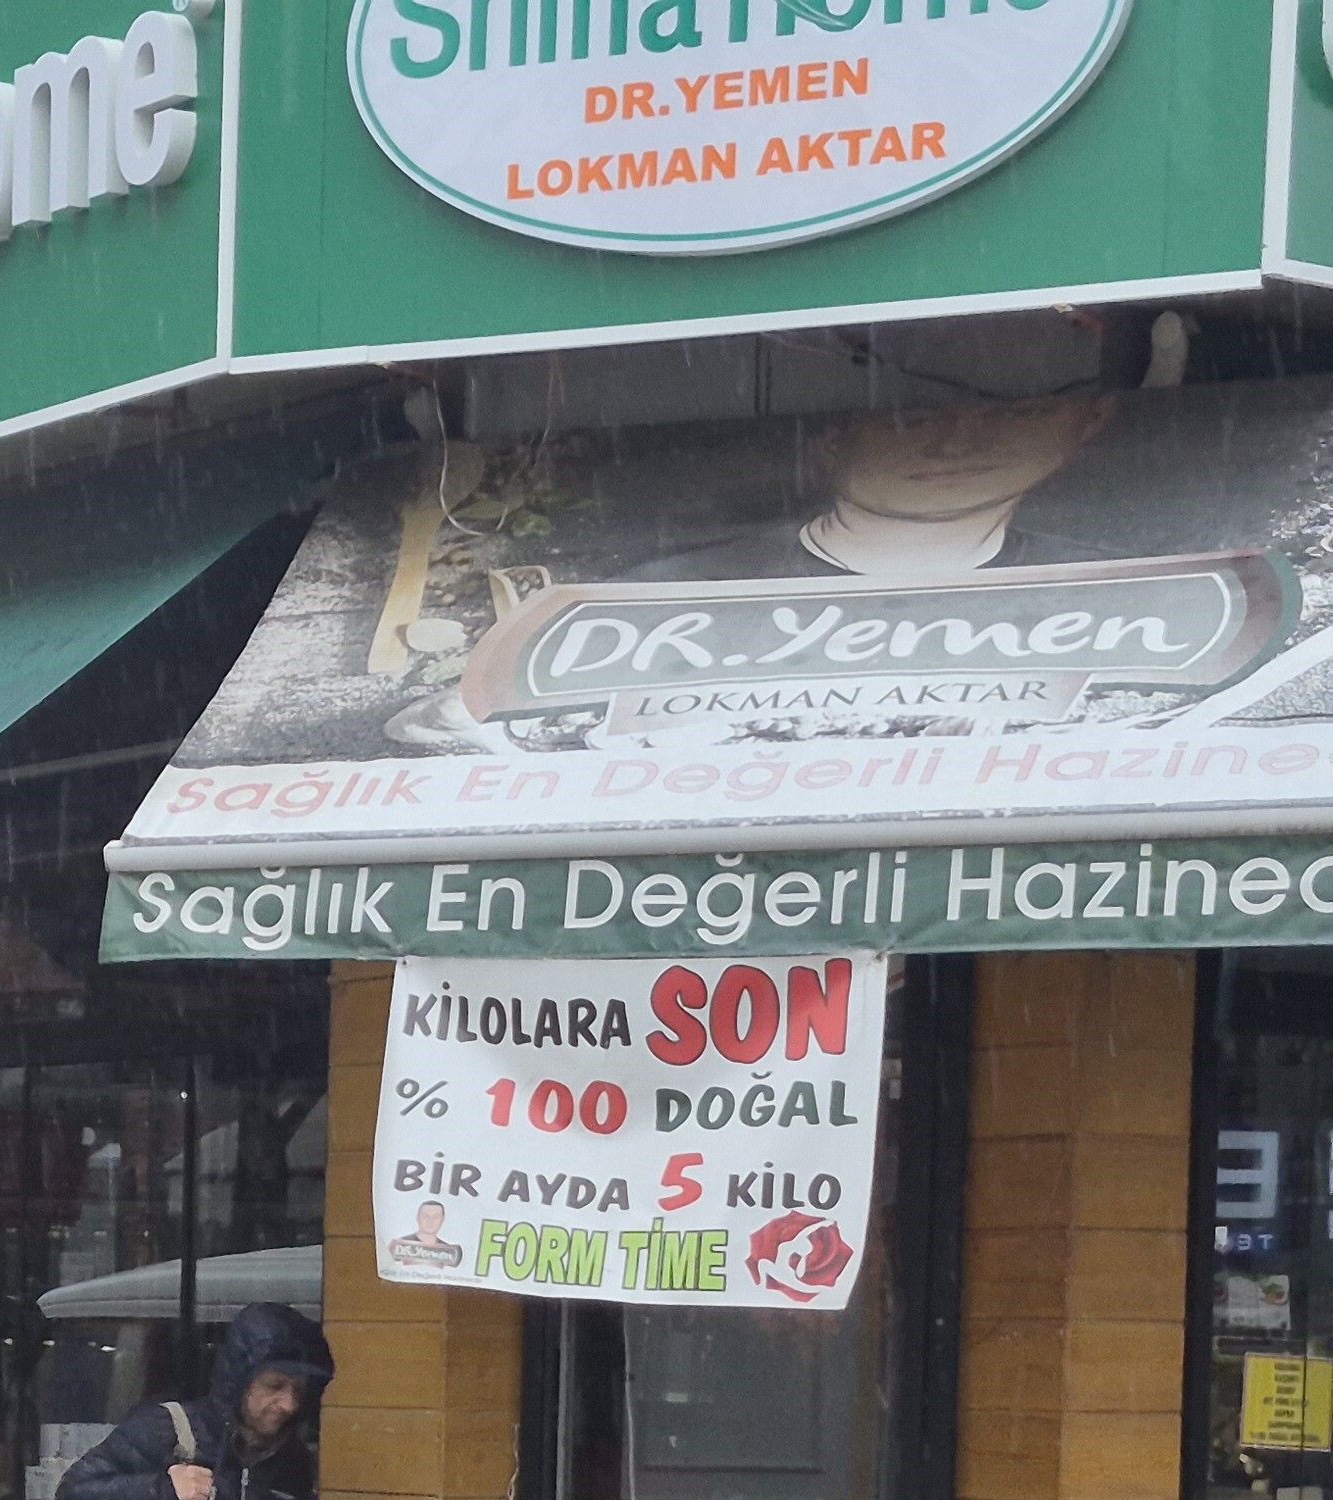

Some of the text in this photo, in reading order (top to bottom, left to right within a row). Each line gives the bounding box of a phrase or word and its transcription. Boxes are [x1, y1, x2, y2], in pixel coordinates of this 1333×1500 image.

[583, 58, 870, 124] DR.YEMEN
[505, 121, 947, 201] LOKMAN AKTAR
[636, 680, 1049, 718] LOKMAN AKTAR
[168, 741, 1333, 819] Sağlık En Değerli Hazine
[133, 866, 394, 952] Sağlık
[427, 864, 525, 932] En
[564, 850, 909, 946] Değerli
[402, 958, 853, 1066] KİLOLARA SON
[396, 1071, 858, 1135] % 100 DOĞAL
[394, 1152, 842, 1213] BİR AYDA 5 KİLO
[475, 1217, 608, 1287] FORM
